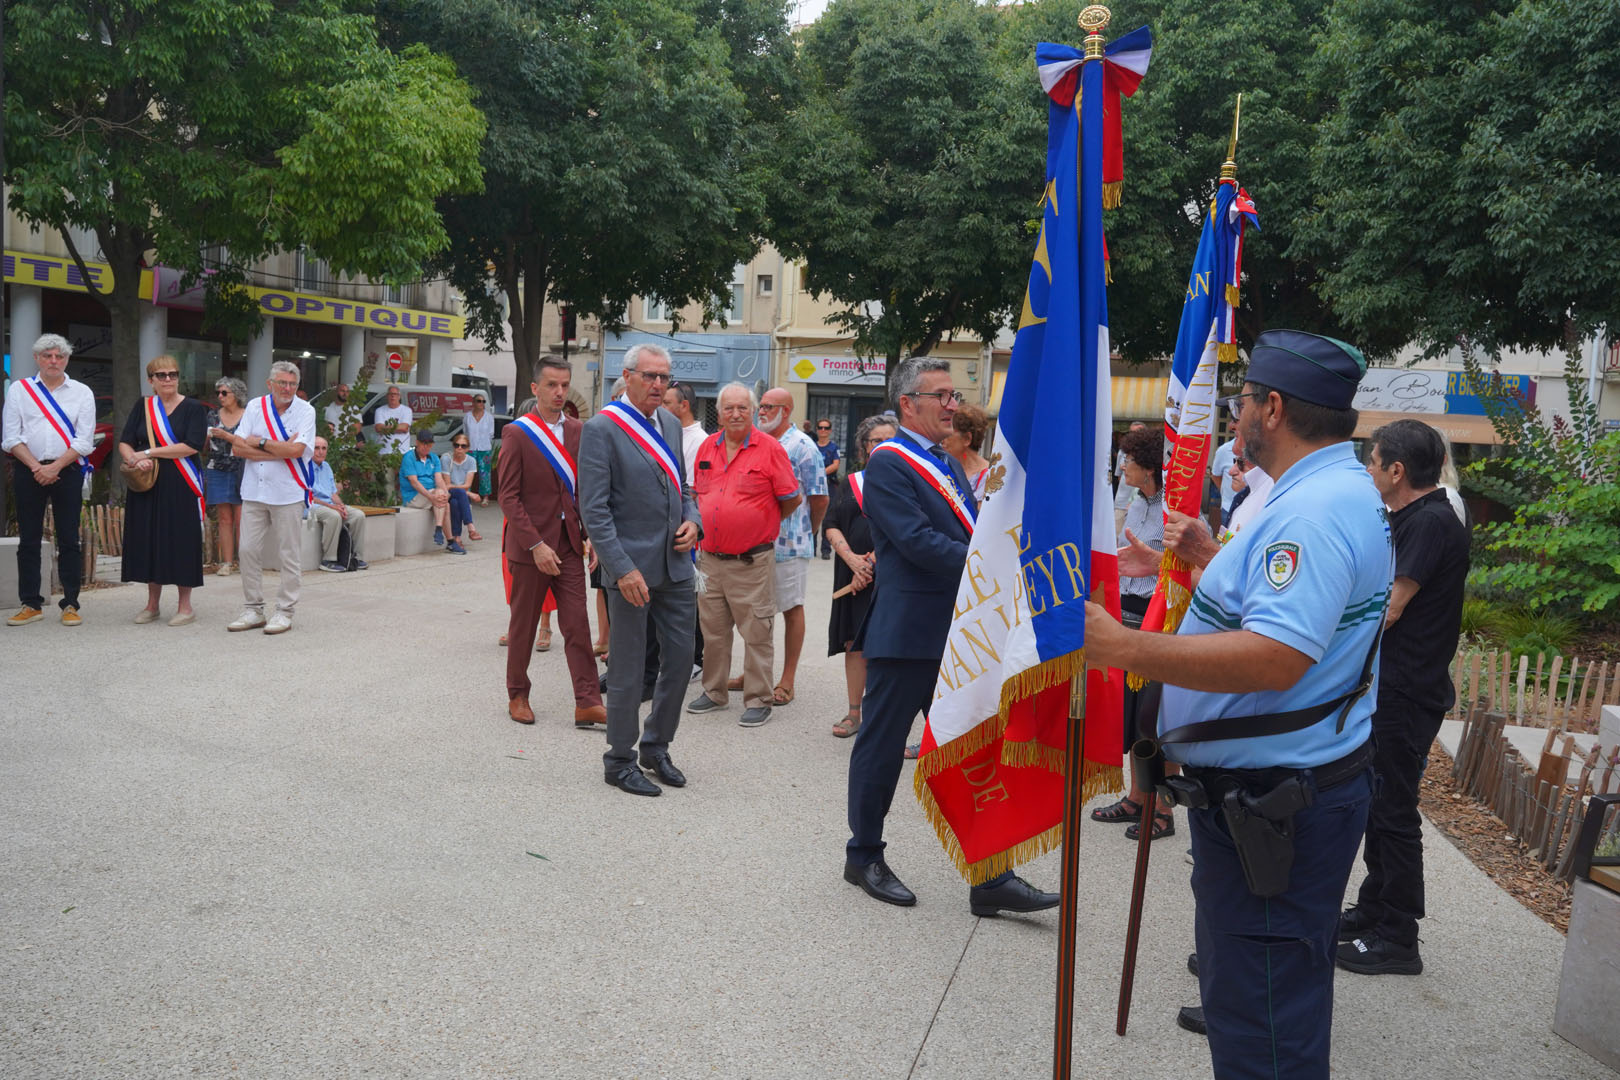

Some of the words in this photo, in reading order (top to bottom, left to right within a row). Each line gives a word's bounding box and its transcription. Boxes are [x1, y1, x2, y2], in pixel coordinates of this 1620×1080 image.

[260, 293, 451, 334] OPTIQUE
[829, 369, 854, 377] immo
[420, 395, 439, 409] RUIZ
